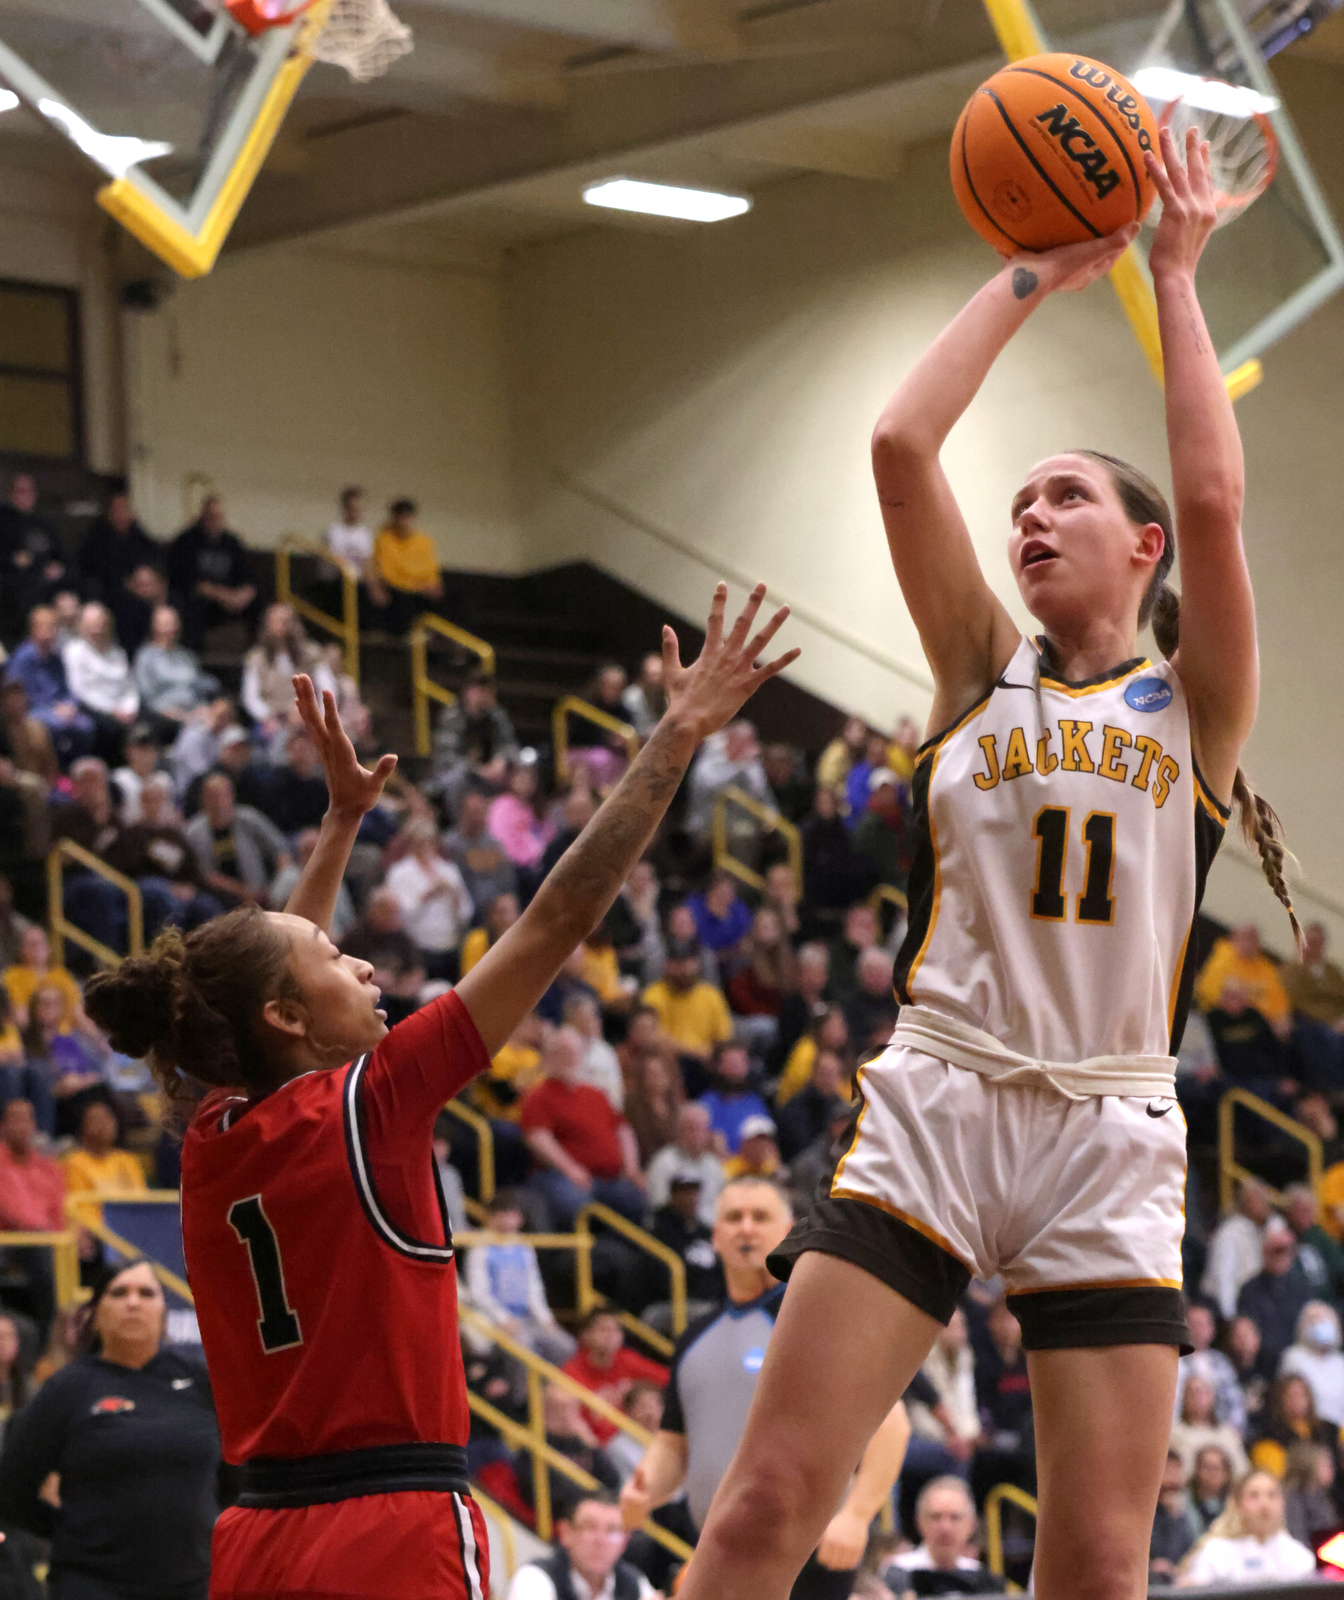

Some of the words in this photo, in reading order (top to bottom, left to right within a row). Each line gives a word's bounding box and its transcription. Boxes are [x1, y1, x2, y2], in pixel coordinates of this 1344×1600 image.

[1036, 103, 1121, 200] NCAA
[1069, 60, 1155, 179] Wilso
[1133, 688, 1171, 706] NCAA
[972, 719, 1180, 809] JACKETS
[1030, 804, 1117, 926] 11
[226, 1193, 303, 1355] 1
